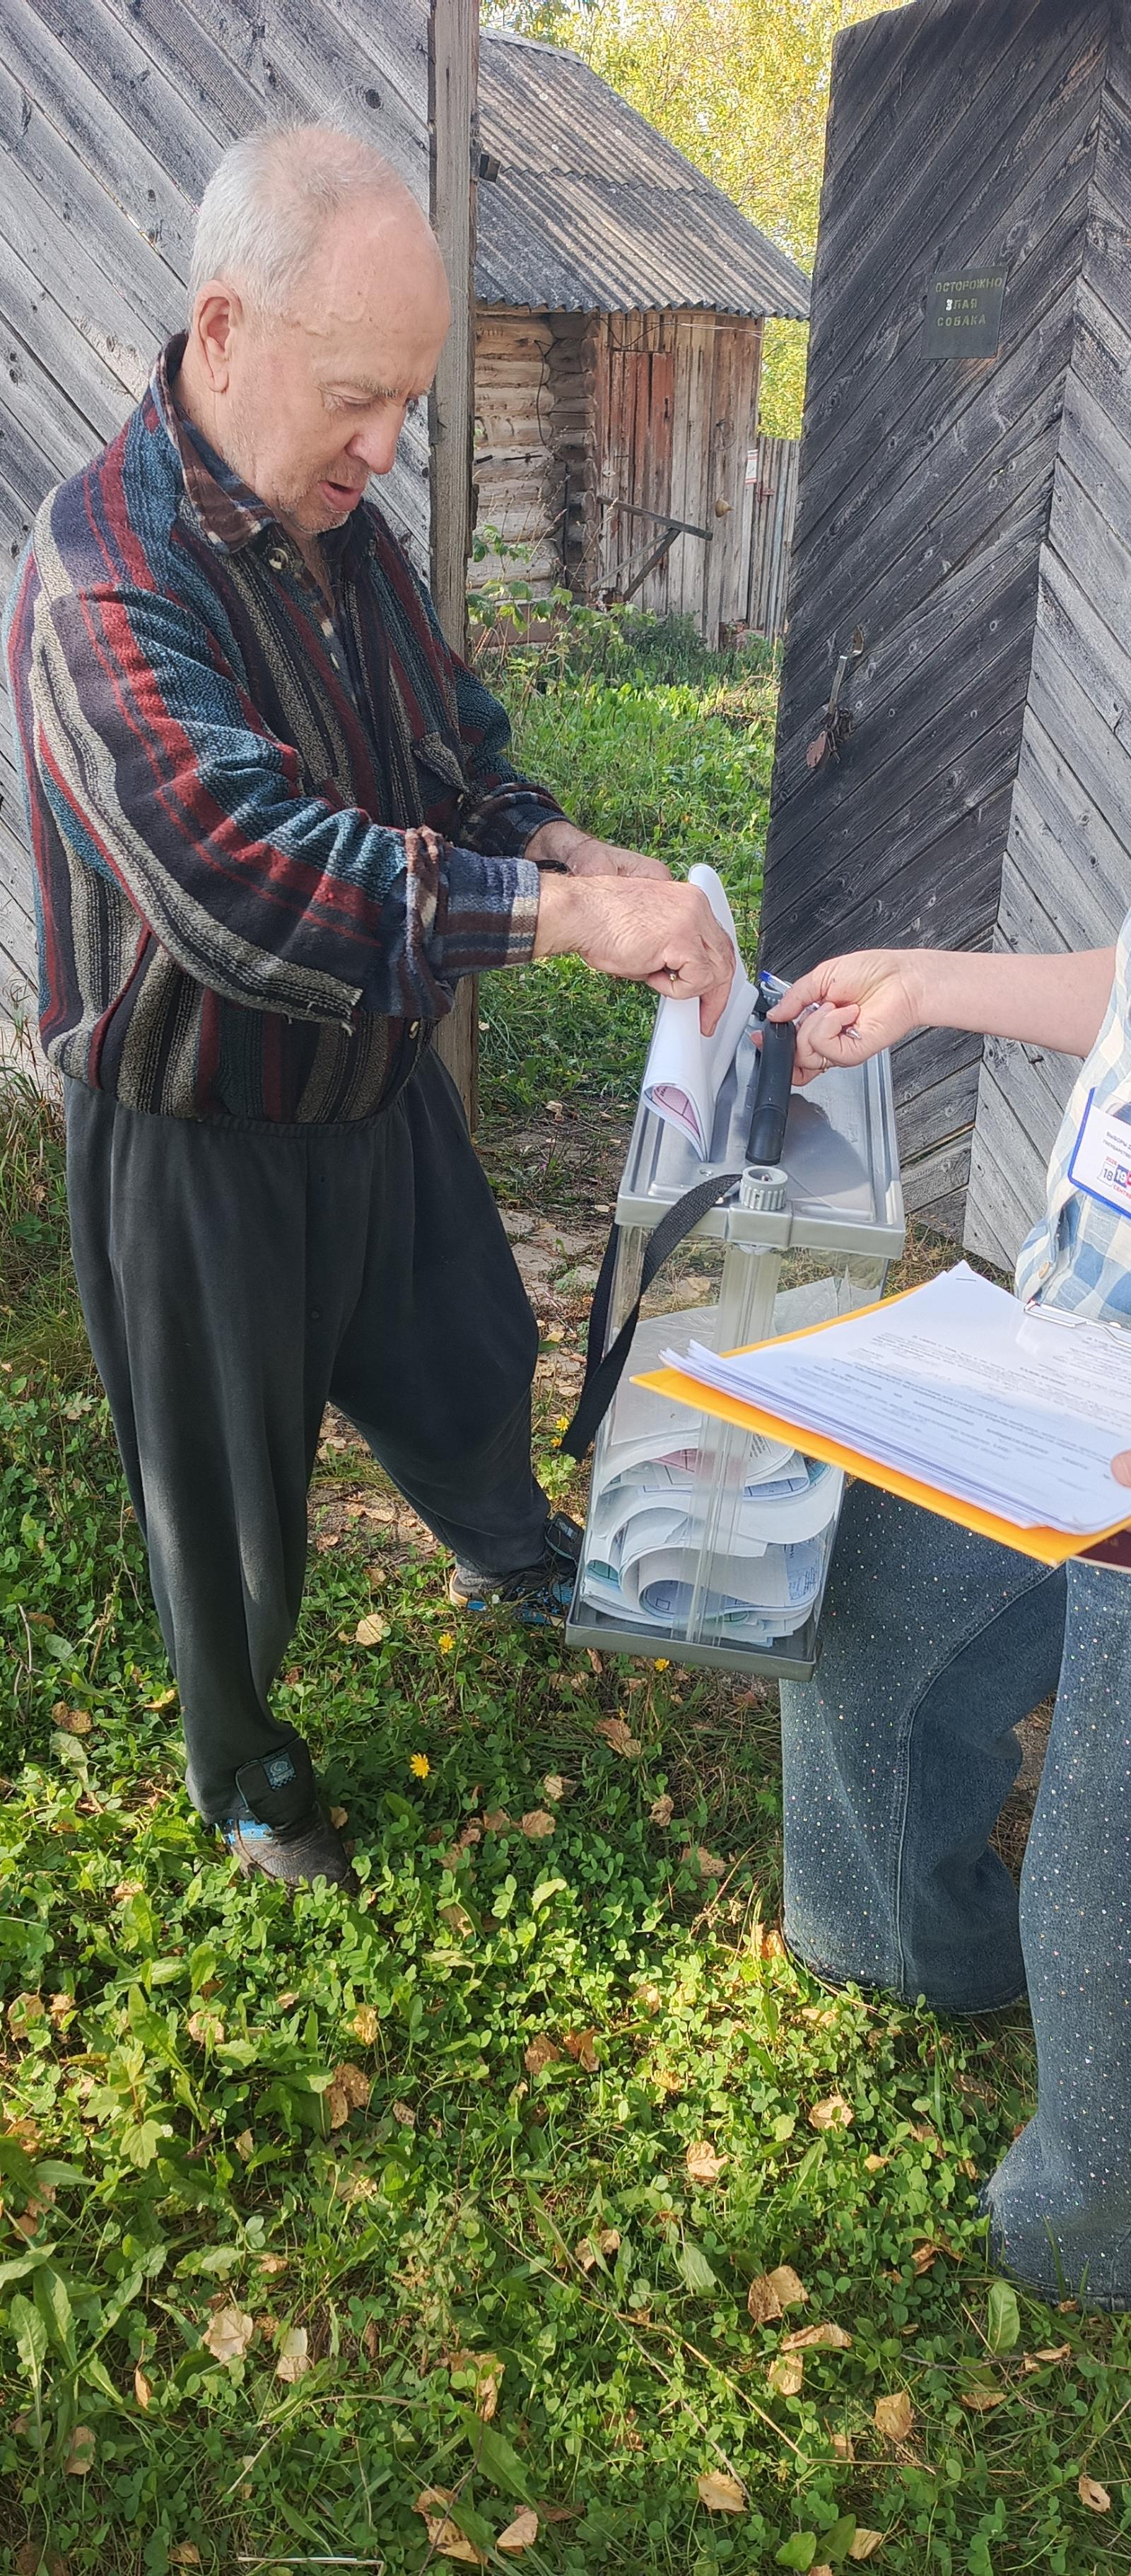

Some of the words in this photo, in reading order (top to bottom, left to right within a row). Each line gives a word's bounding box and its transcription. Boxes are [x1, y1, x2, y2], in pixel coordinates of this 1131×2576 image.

[935, 277, 1002, 293] ОСТОРОЖНО
[946, 298, 978, 310] ЗЛАЯ
[937, 314, 986, 327] СОБАКА
[1103, 1169, 1113, 1181] 18
[1115, 1169, 1127, 1183] 19
